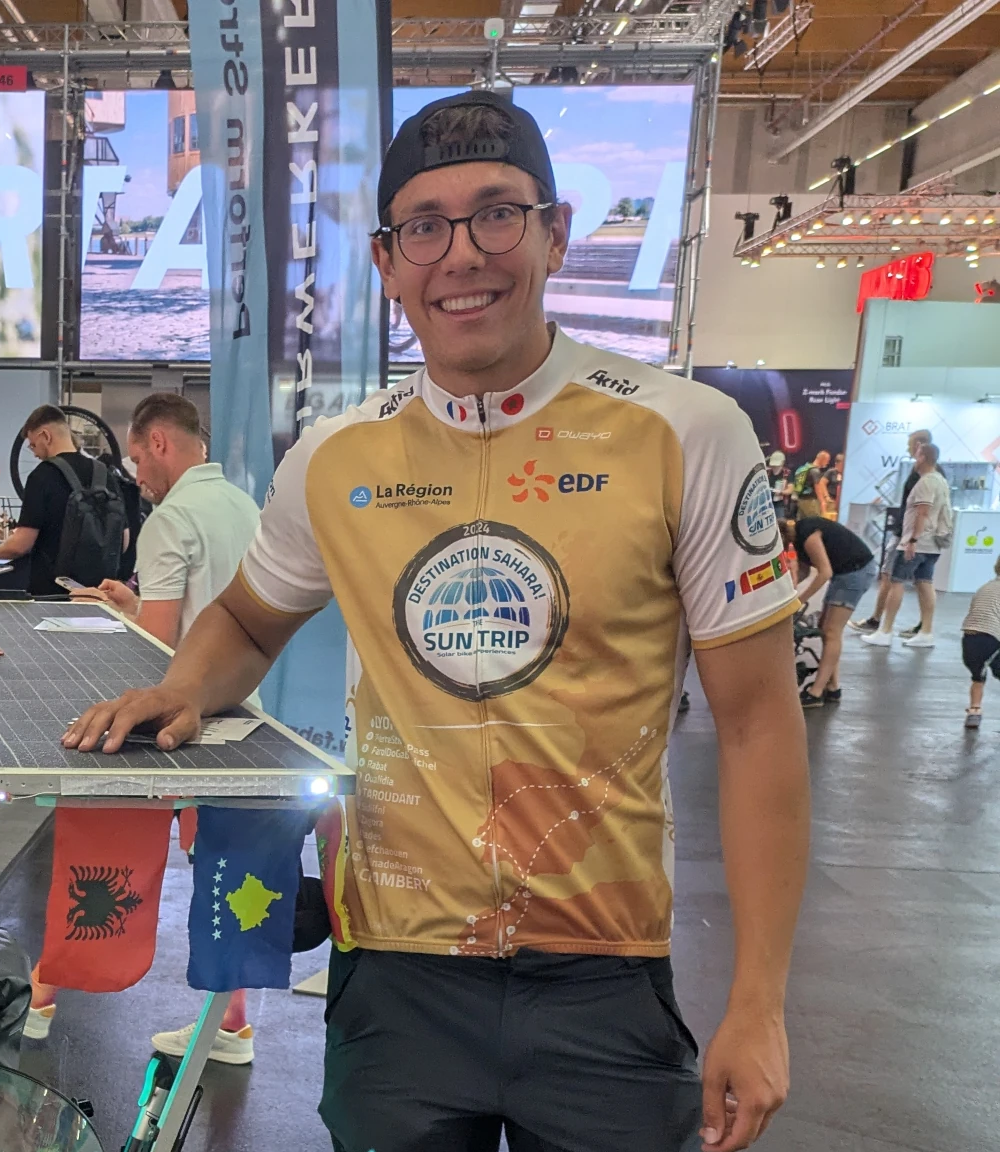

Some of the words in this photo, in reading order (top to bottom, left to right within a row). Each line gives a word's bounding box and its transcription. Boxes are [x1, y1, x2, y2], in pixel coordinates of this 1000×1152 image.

[376, 484, 393, 499] La
[395, 483, 453, 499] Région
[462, 521, 490, 536] 2024
[408, 546, 489, 604] DESTINATION
[492, 549, 546, 600] SAHARA!
[423, 632, 473, 651] SUN
[475, 630, 530, 649] TRIP
[367, 759, 387, 772] Rabat
[361, 787, 421, 806] TAROUDANT
